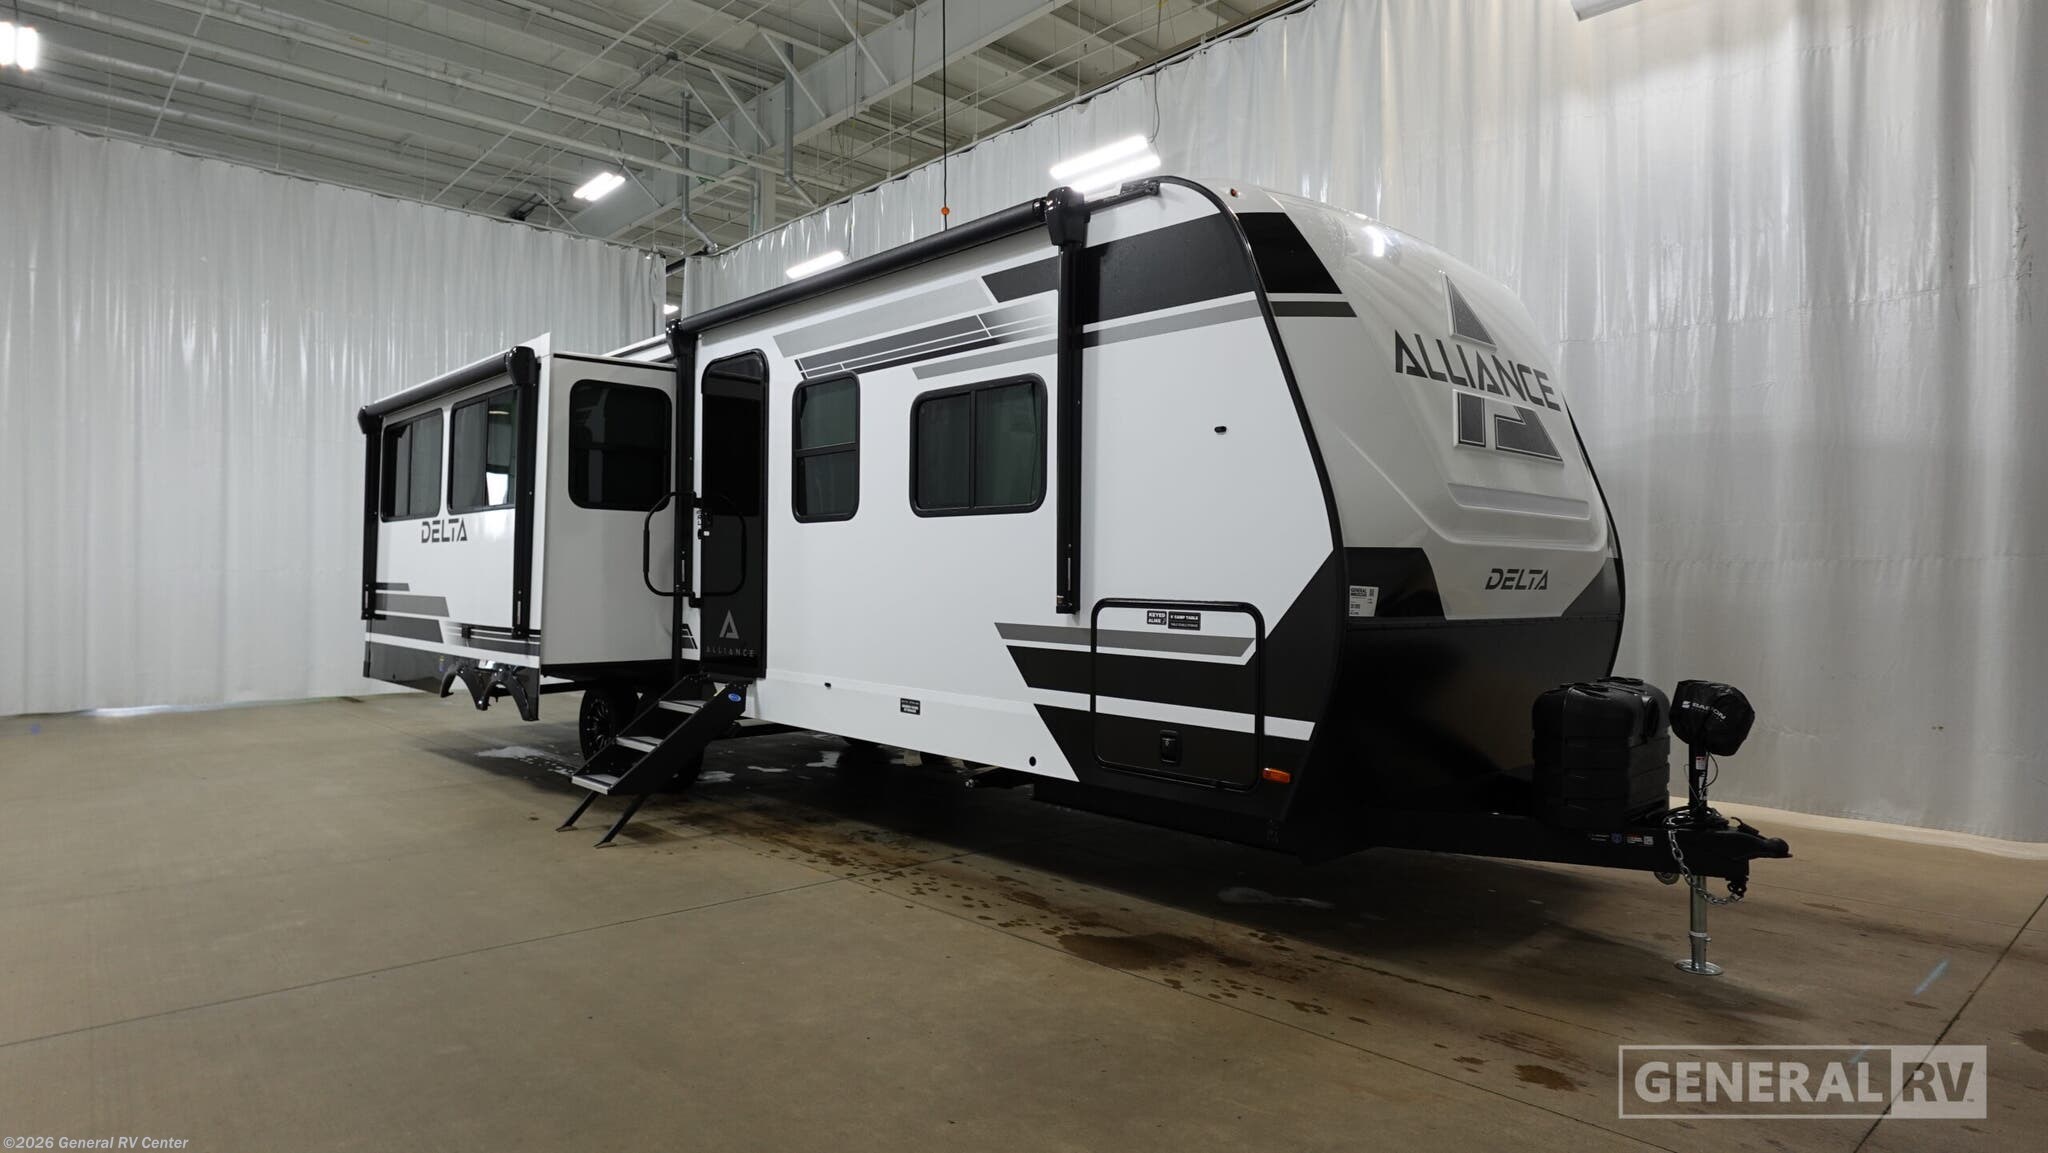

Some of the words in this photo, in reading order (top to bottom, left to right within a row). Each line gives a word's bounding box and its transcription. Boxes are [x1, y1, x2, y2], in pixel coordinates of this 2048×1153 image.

[1394, 329, 1562, 412] ALLIANCE
[421, 518, 467, 543] DELTA
[1484, 568, 1549, 591] DELTA
[706, 645, 754, 657] ALLIANCE
